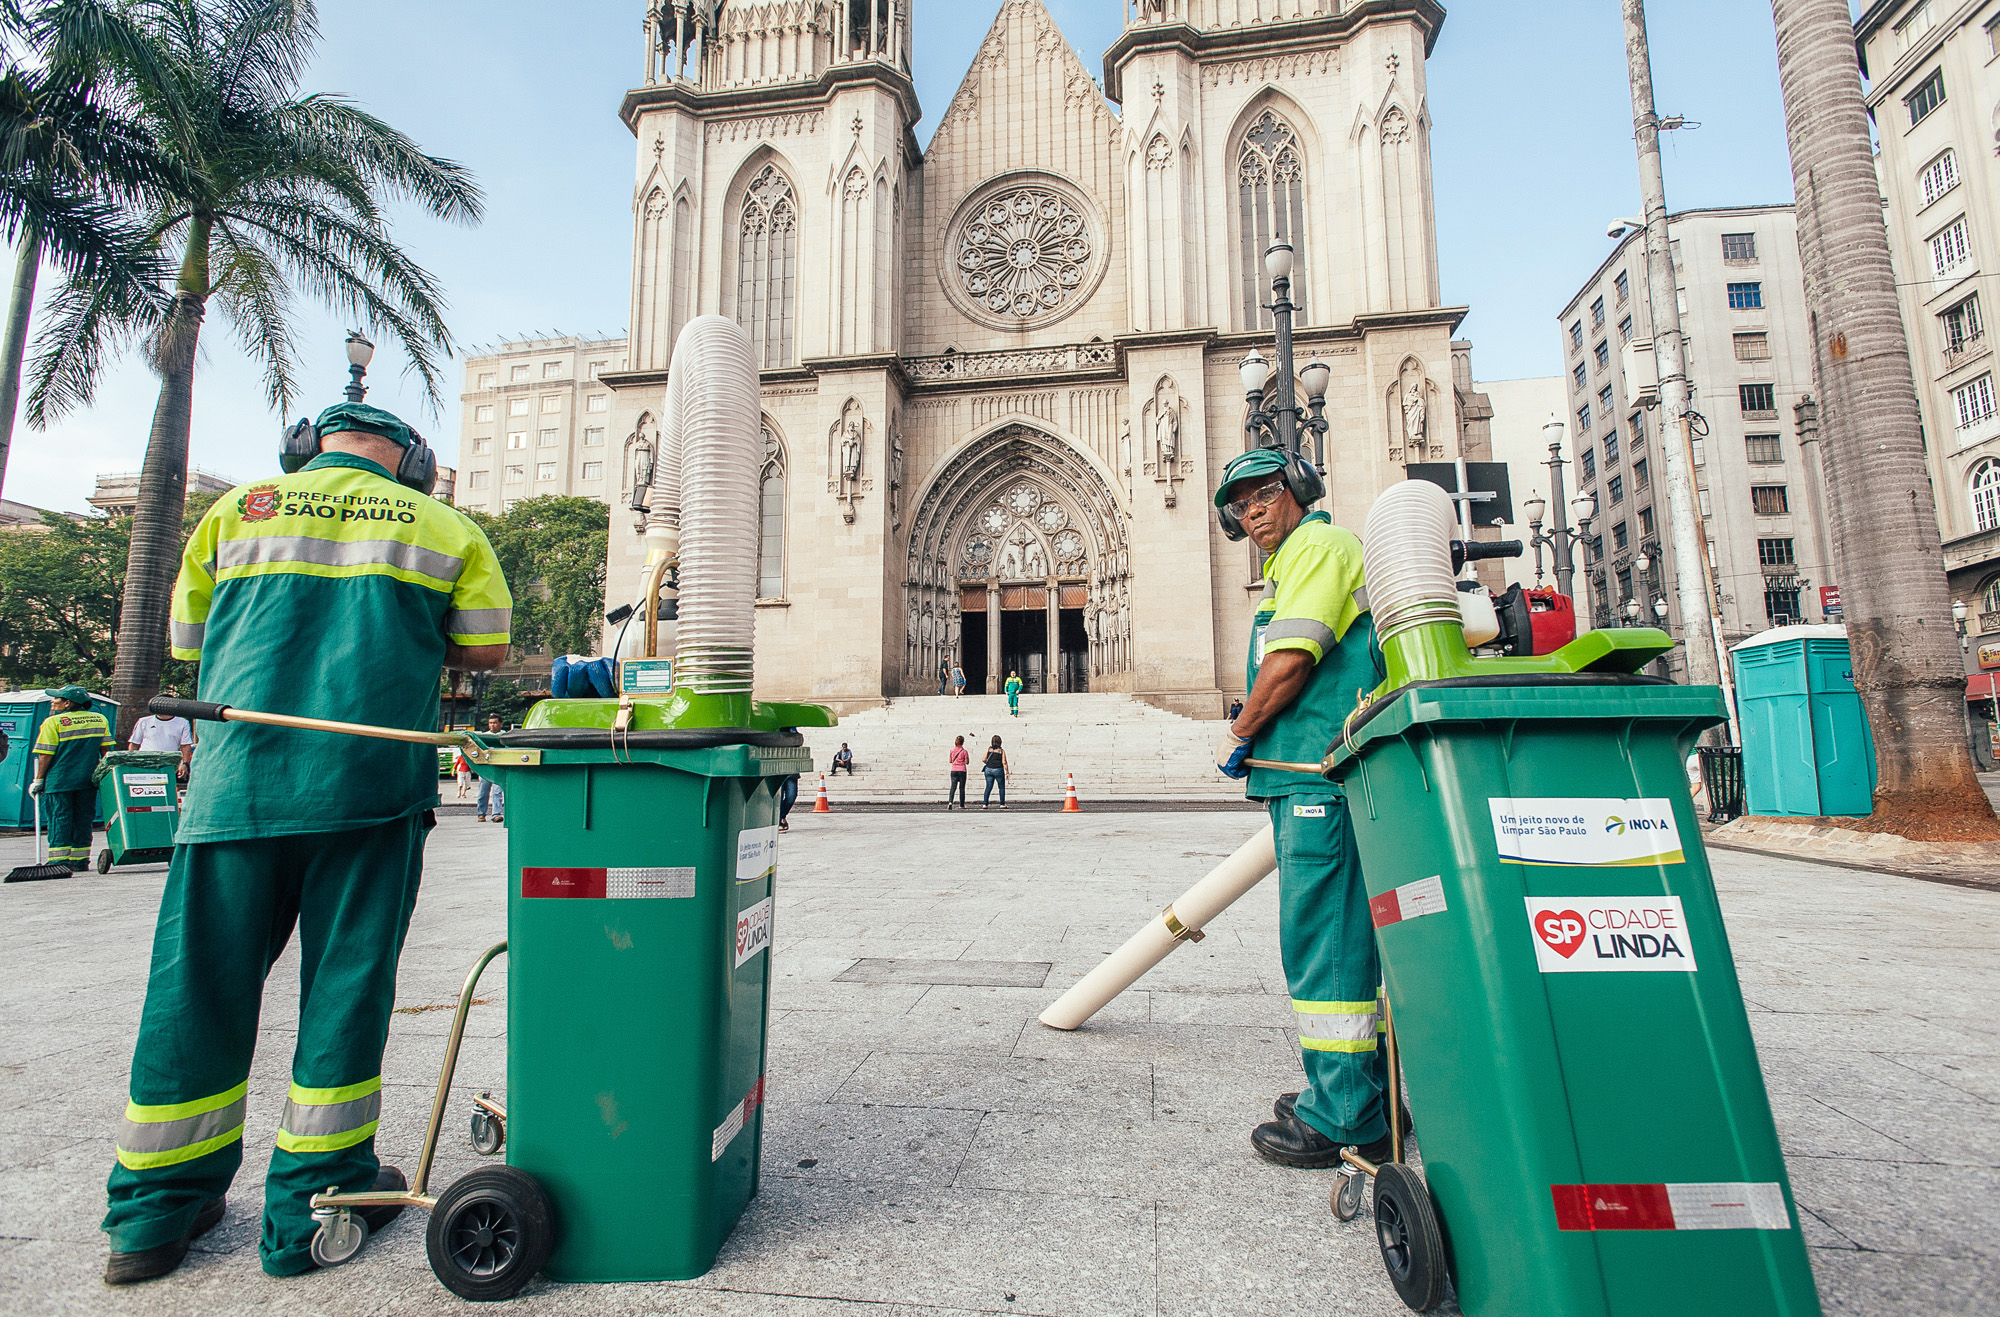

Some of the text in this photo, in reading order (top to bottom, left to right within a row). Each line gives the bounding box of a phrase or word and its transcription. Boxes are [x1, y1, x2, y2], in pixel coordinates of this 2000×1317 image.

[284, 501, 336, 519] SÃO
[340, 507, 416, 524] PAULO
[286, 491, 418, 511] PREFEITURA DE
[1500, 815, 1669, 831] Um jeito novo de INOVA
[1502, 824, 1587, 837] limpar São Paulo
[749, 904, 770, 929] CIDADE
[1588, 909, 1678, 930] CIDADE
[737, 924, 747, 947] SP
[747, 923, 768, 951] LINDA
[1543, 918, 1582, 944] SP
[1593, 933, 1685, 959] LINDA
